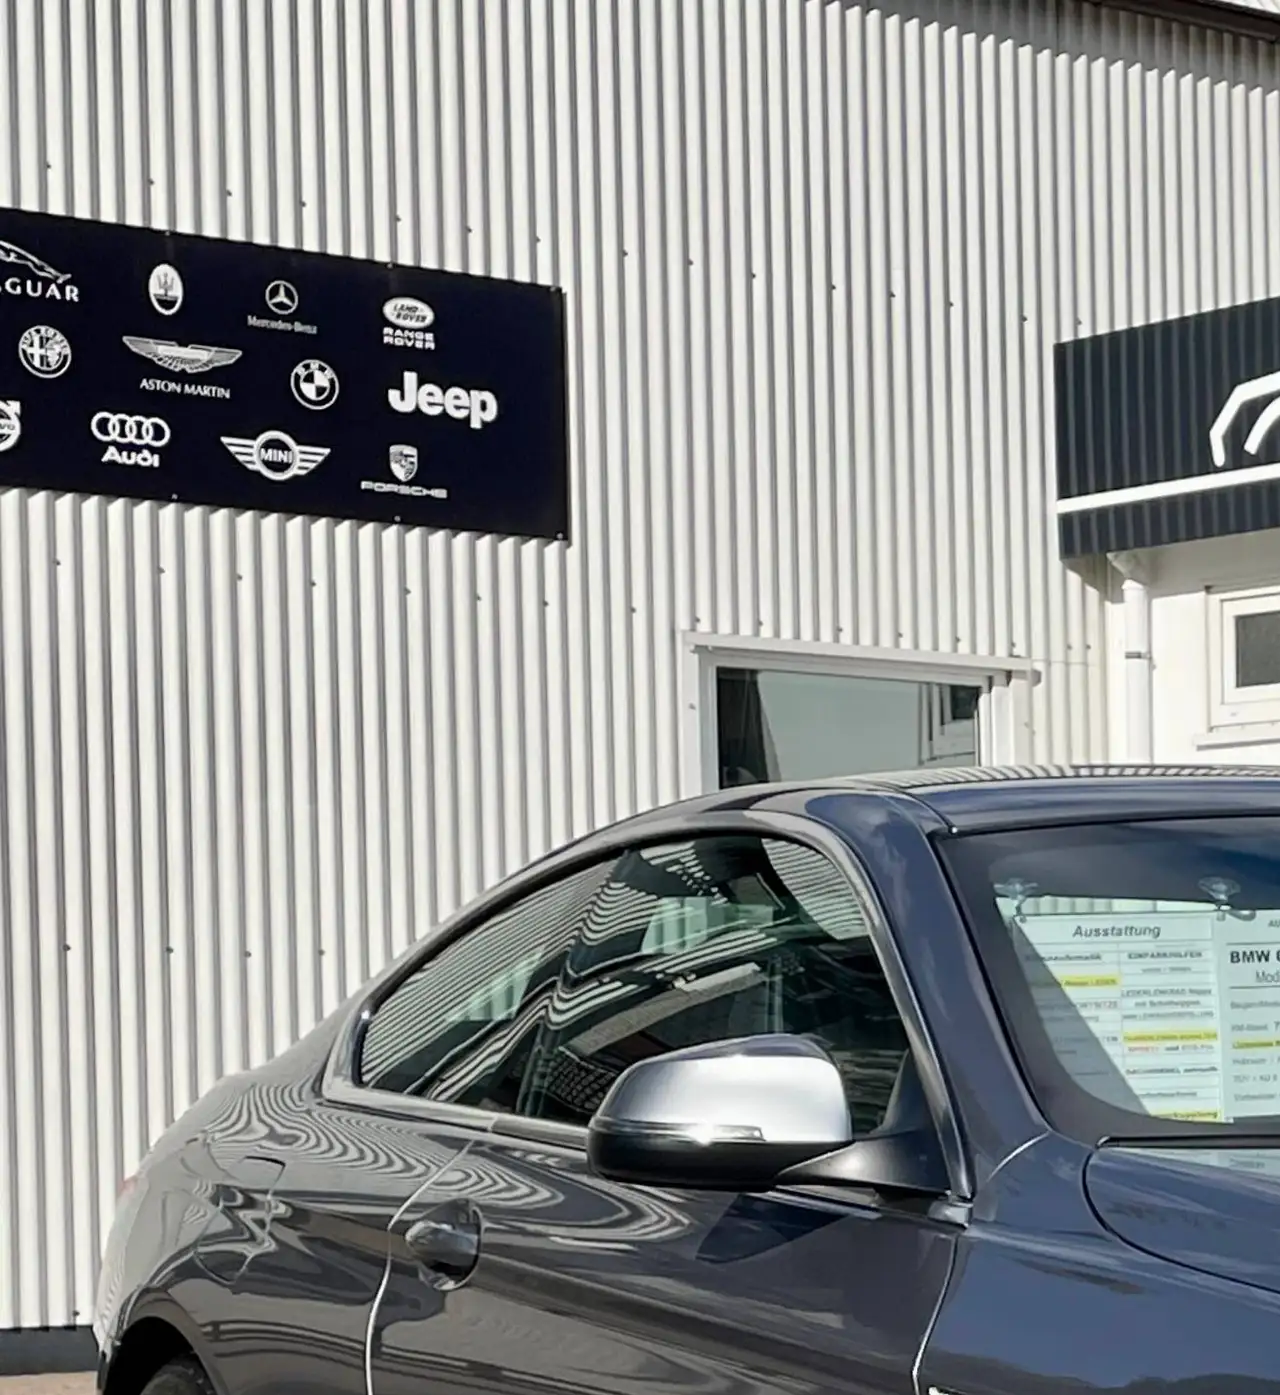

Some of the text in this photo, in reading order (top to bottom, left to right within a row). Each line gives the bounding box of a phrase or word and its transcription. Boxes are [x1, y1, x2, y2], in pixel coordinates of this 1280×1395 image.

[0, 277, 79, 302] GUAR
[383, 327, 434, 341] RANGE
[383, 336, 436, 350] ROVER
[139, 378, 231, 399] ASTON MARTIN
[388, 371, 498, 429] Jeep
[101, 445, 161, 468] Audi
[260, 447, 293, 464] MINI
[361, 481, 448, 499] PORSCHE
[1072, 925, 1162, 939] Ausstattung
[1230, 950, 1270, 964] BMW
